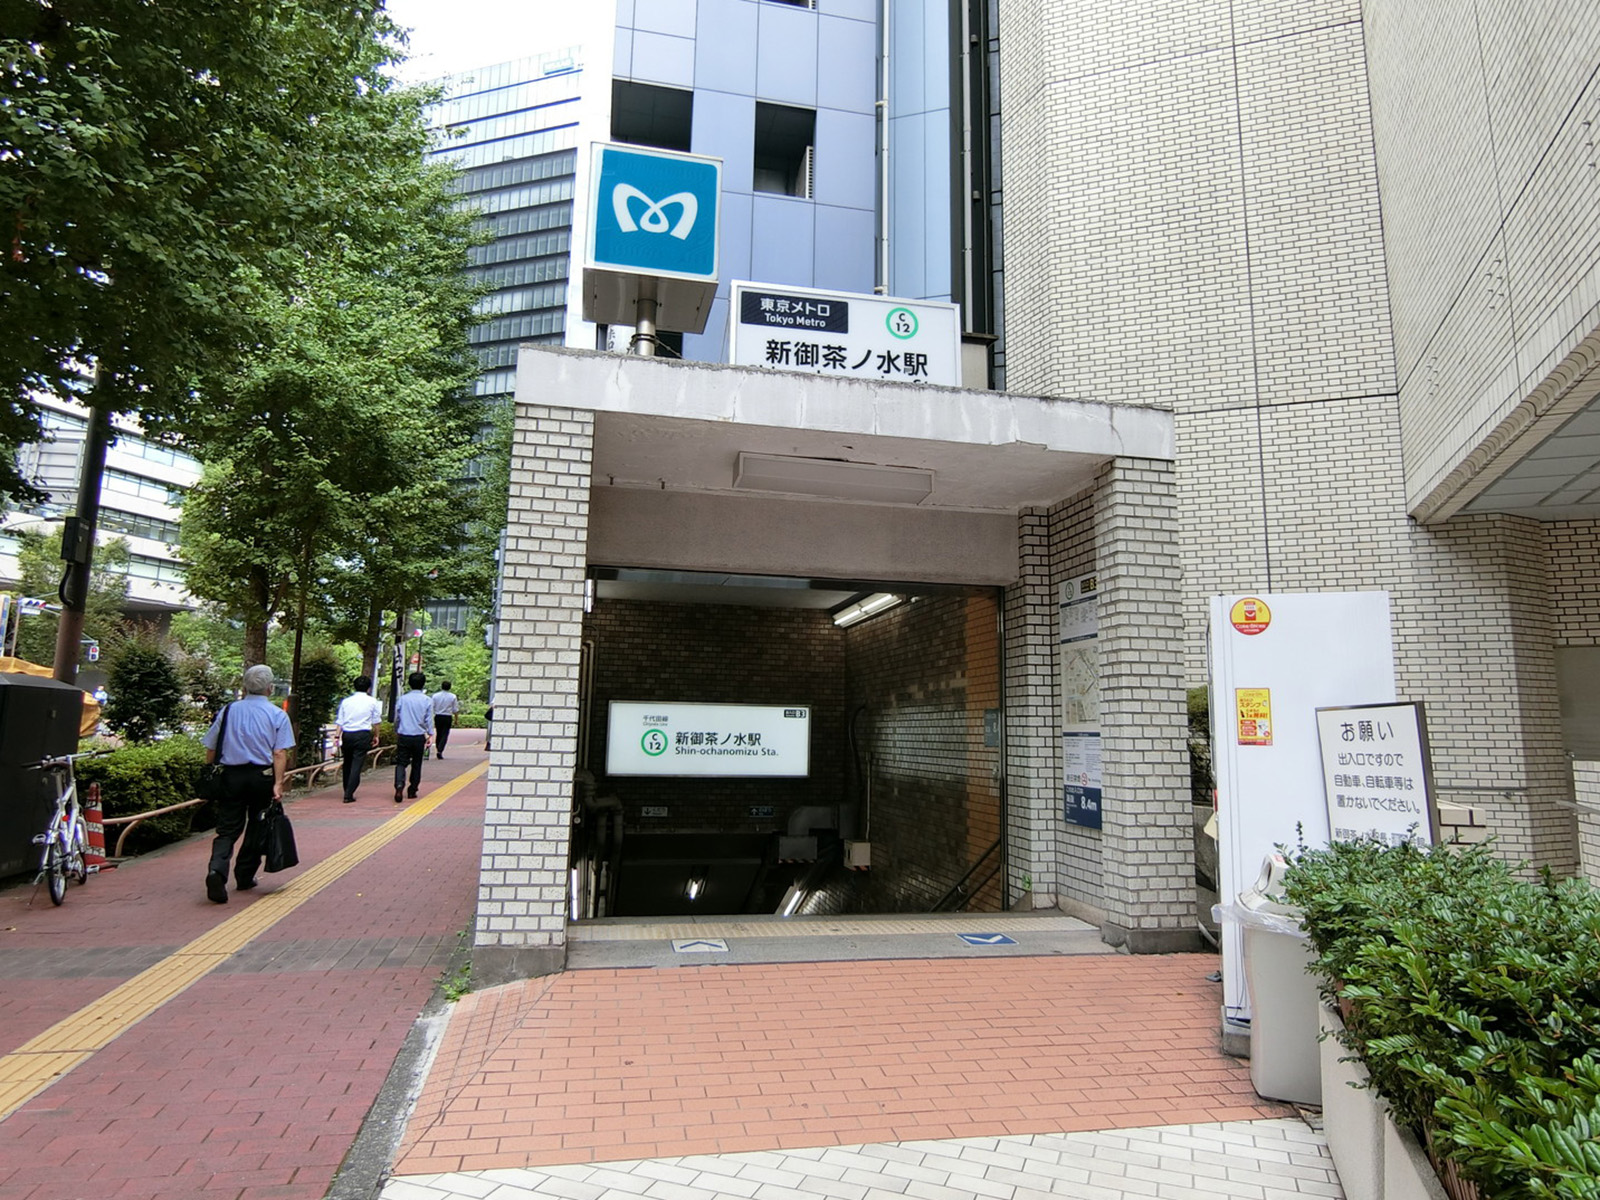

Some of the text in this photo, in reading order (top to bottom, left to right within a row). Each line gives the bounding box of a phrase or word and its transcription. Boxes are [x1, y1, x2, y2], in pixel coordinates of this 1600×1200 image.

[760, 298, 830, 317] 東京メトロ
[764, 312, 826, 328] Tokyo Metro
[898, 312, 906, 322] C
[895, 322, 910, 333] 12
[765, 338, 928, 377] 新御茶ノ水駅
[651, 733, 658, 742] C
[675, 731, 761, 746] 新御茶ノ水駅
[1340, 720, 1394, 742] お願い
[649, 742, 661, 750] 12
[675, 747, 779, 756] Shin-ochanomizu Sta.
[1338, 752, 1404, 767] 出入口ですので
[1334, 774, 1414, 790] 自動車、自転車等は
[1080, 795, 1098, 811] 8.4m
[1337, 794, 1420, 814] 置かないでください。
